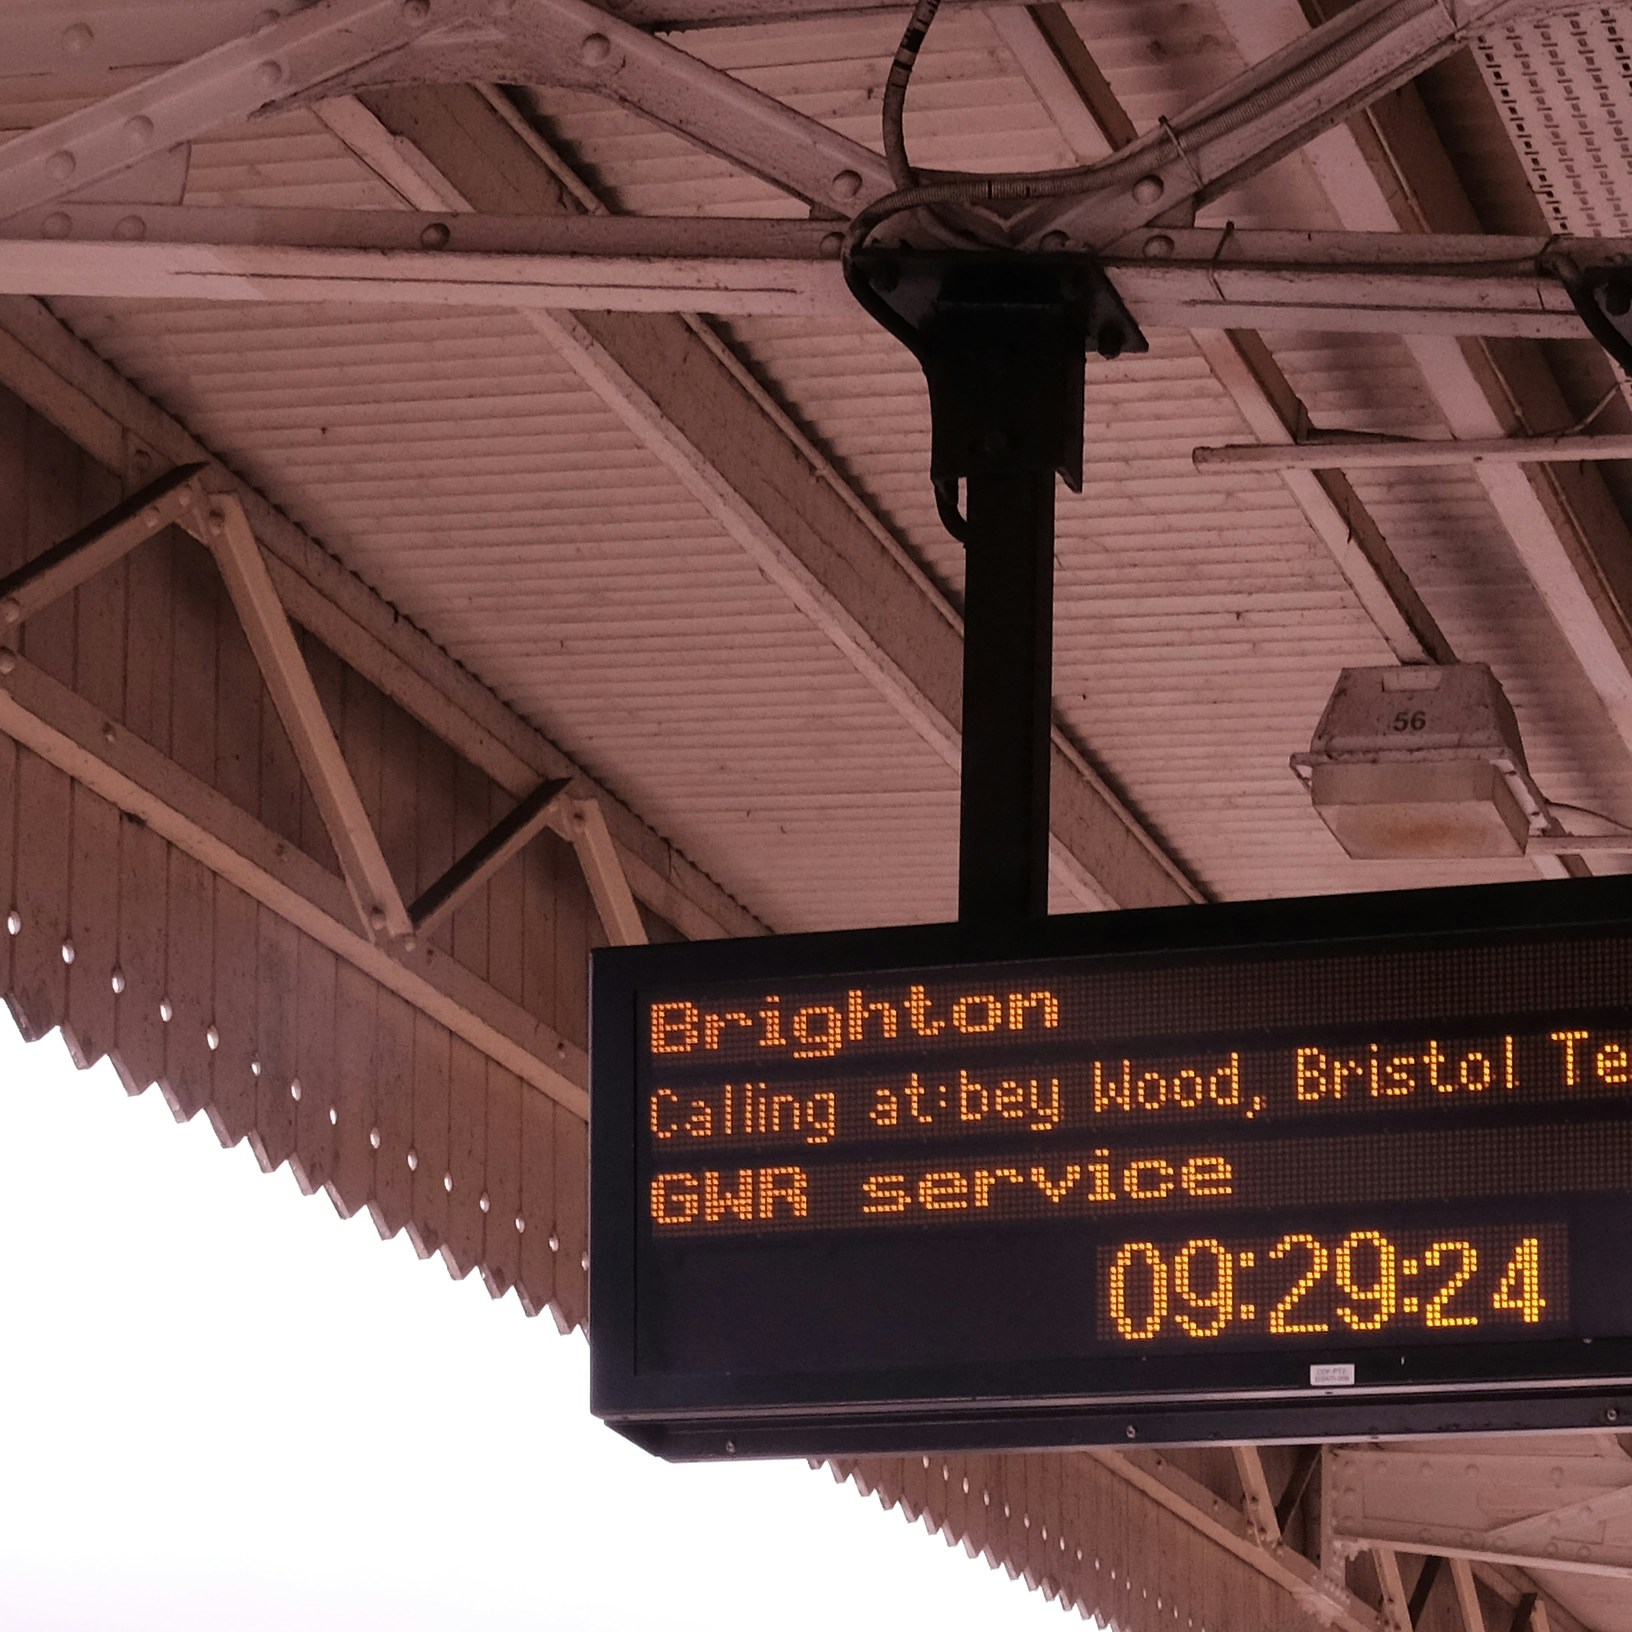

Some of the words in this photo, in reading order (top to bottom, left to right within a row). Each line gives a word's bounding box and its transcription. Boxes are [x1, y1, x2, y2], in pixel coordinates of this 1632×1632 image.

[1393, 711, 1427, 732] 56
[651, 985, 1059, 1059] Brighton
[650, 1082, 836, 1144] Calling
[1094, 1052, 1266, 1119] Wood,
[1296, 1035, 1520, 1101] Bristol
[650, 1166, 808, 1224] GWR
[862, 1148, 1233, 1213] service
[1109, 1230, 1547, 1340] 09:29:24
